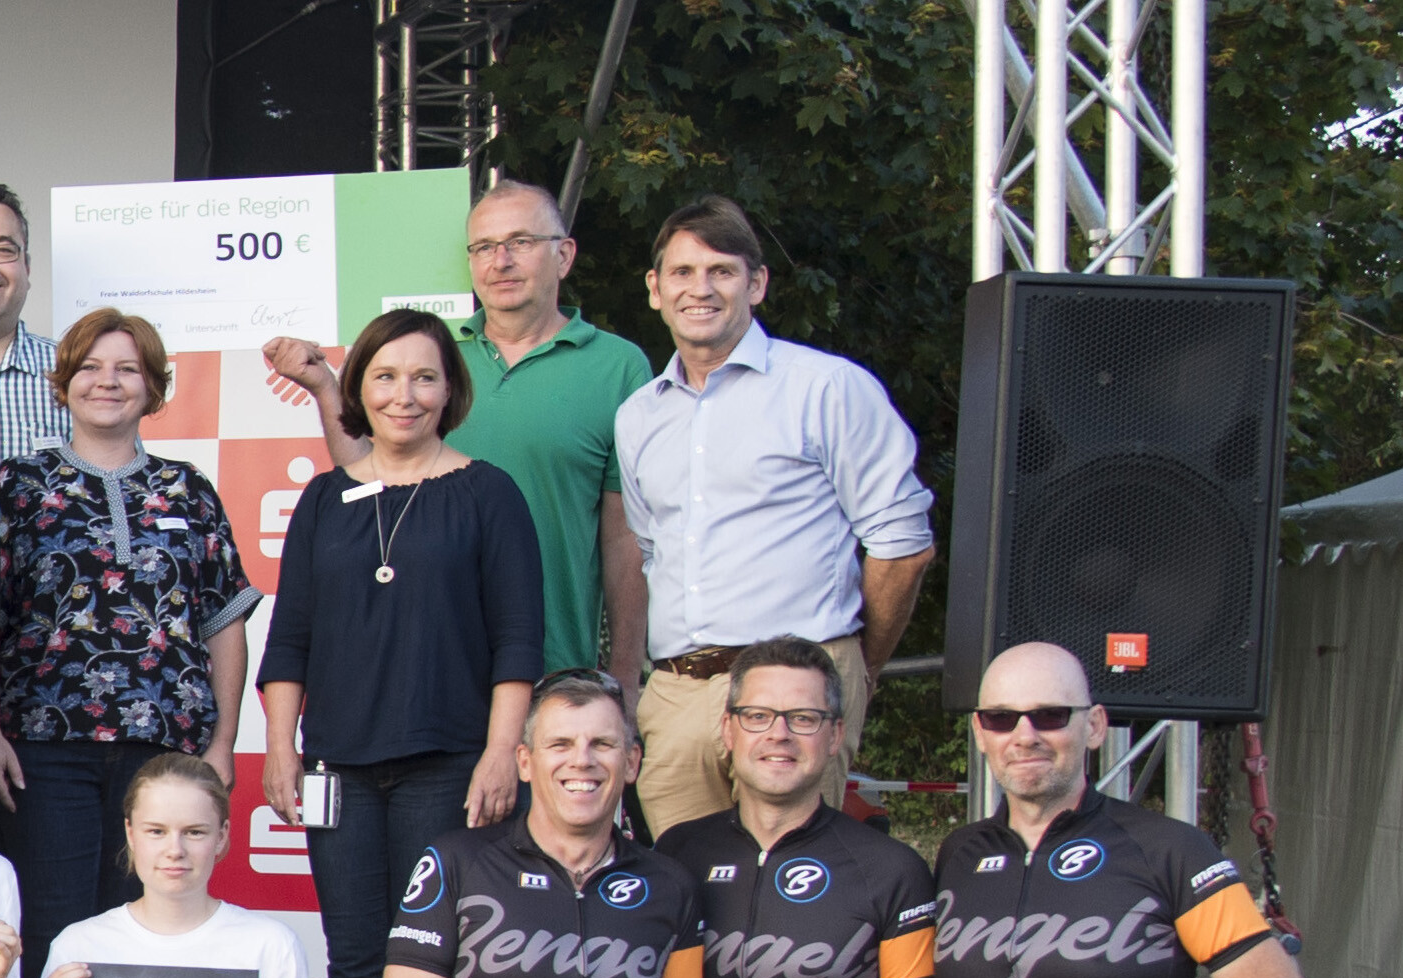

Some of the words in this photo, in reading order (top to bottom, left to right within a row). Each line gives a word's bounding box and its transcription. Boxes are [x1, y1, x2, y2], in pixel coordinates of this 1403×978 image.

[75, 202, 152, 225] Energie
[161, 200, 190, 220] für
[197, 198, 230, 217] die
[241, 196, 310, 220] Region
[216, 231, 283, 261] 500
[294, 234, 310, 253] €
[1114, 642, 1140, 657] JBL
